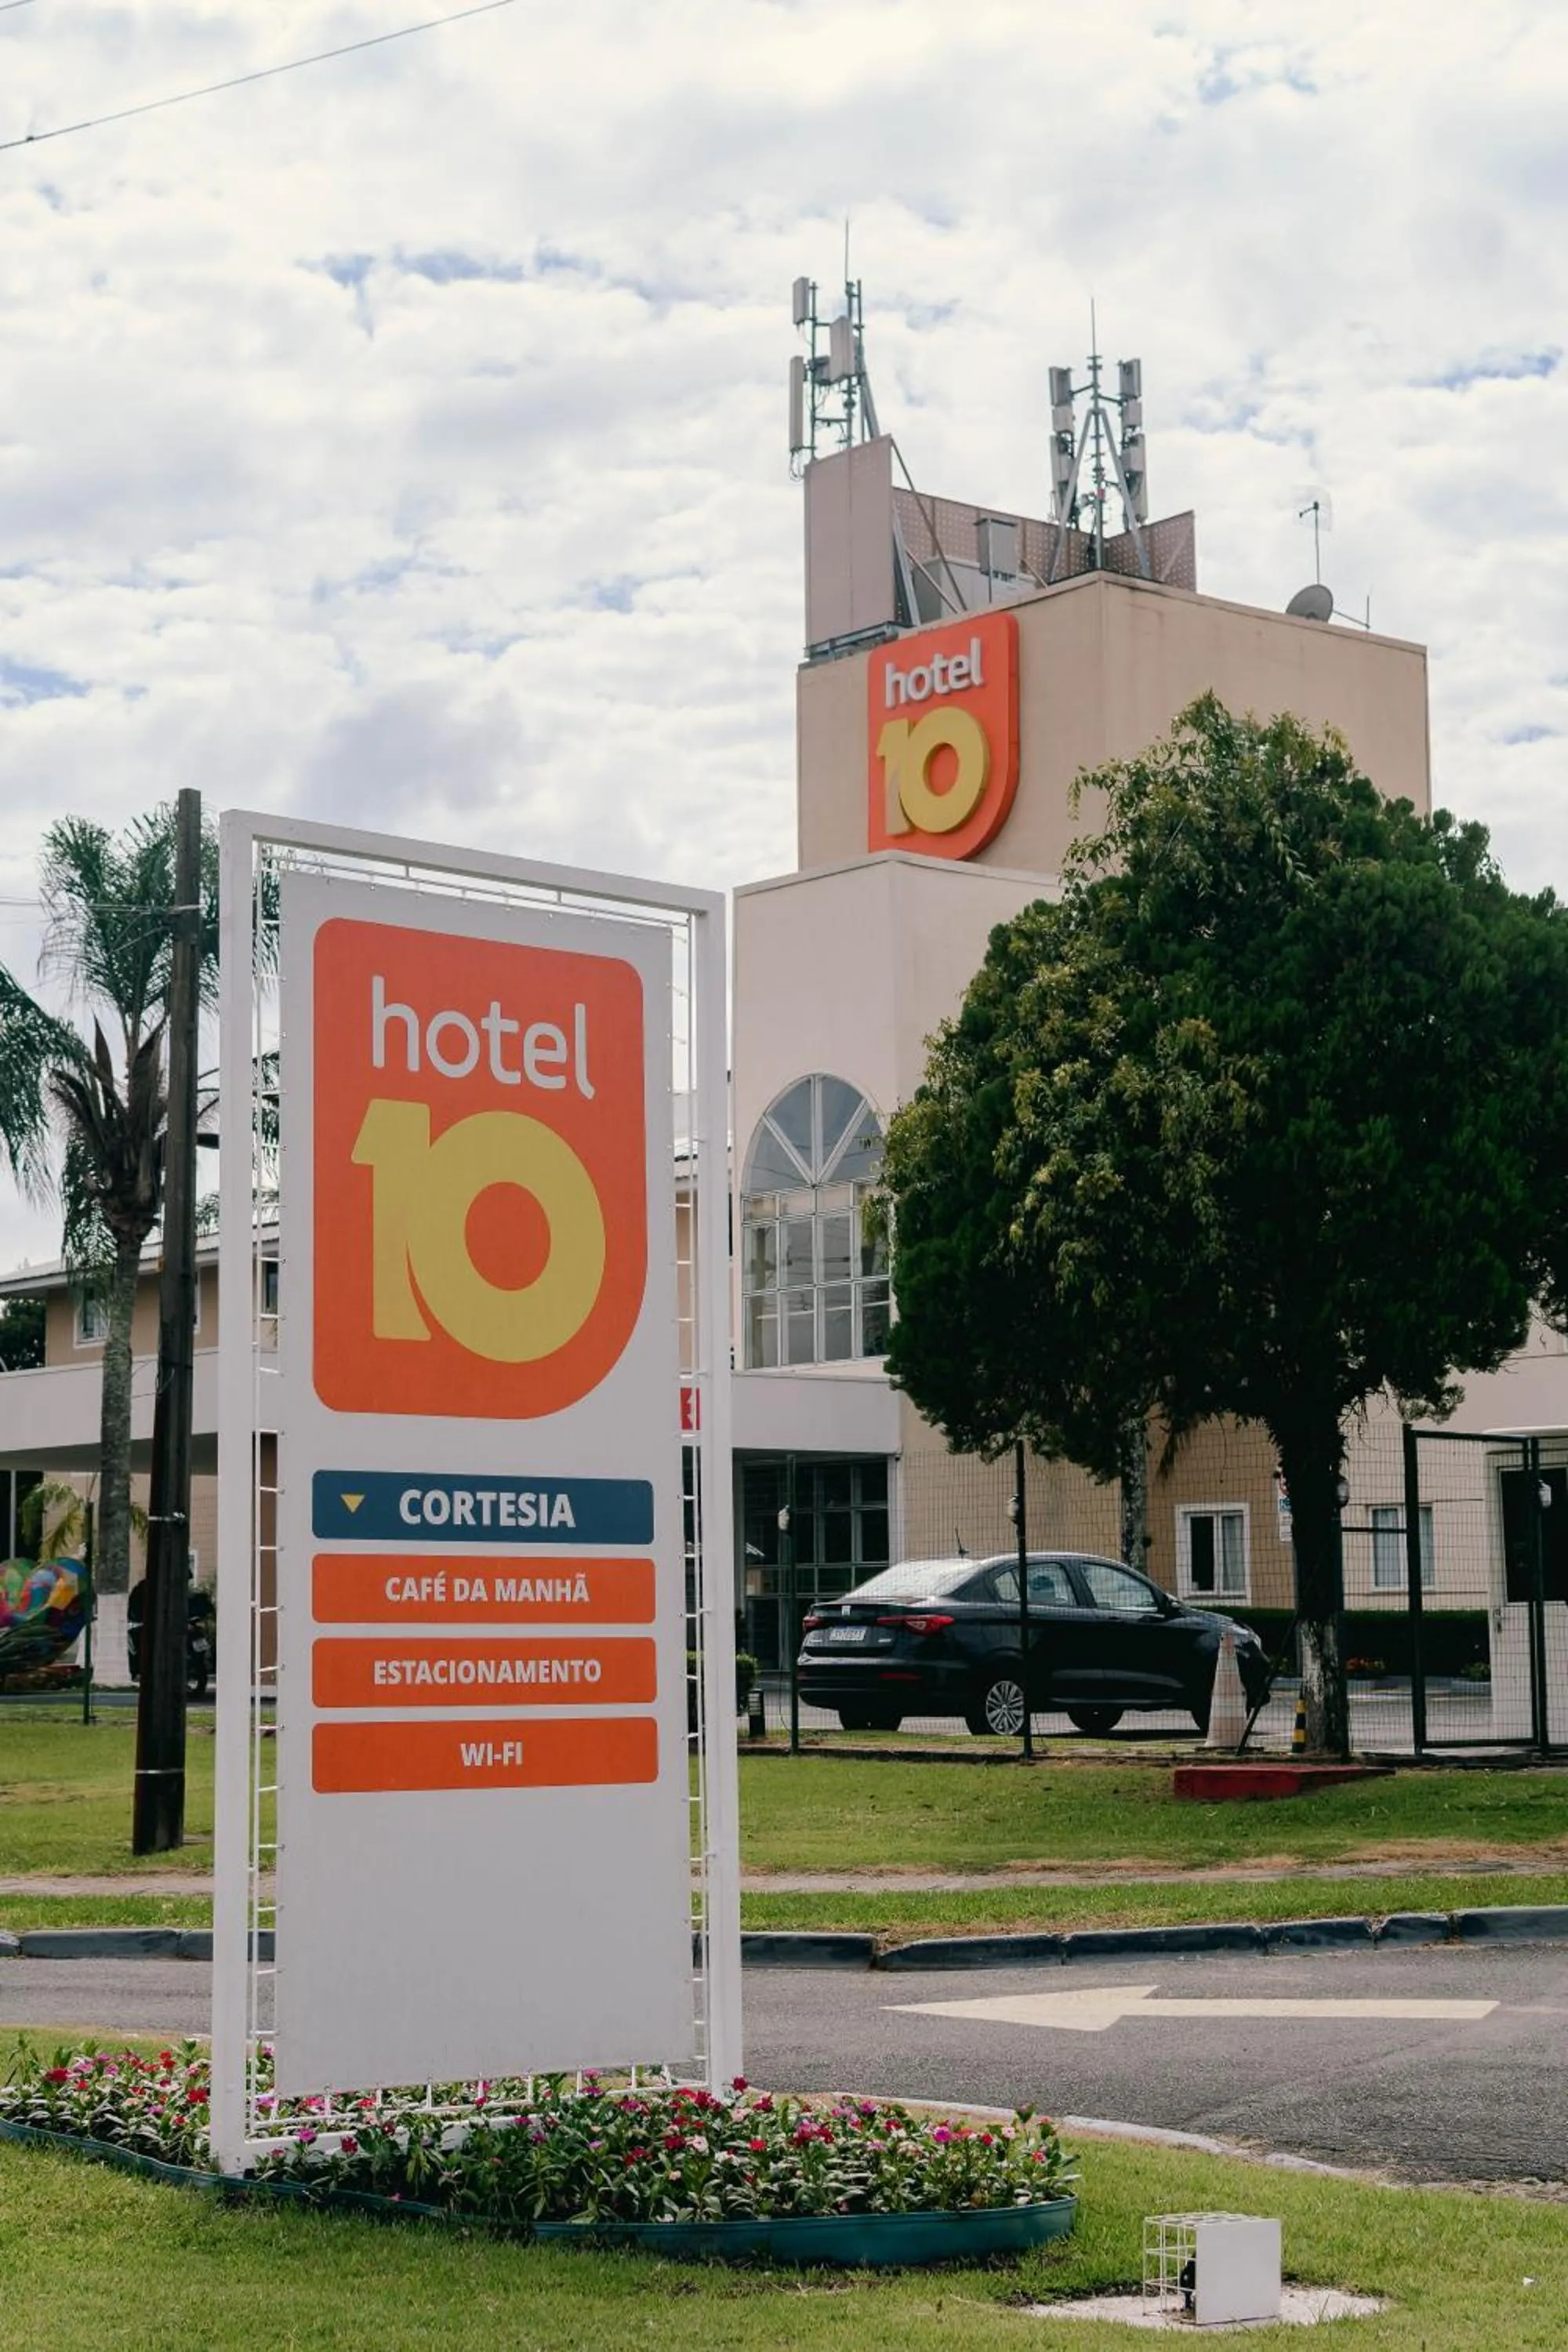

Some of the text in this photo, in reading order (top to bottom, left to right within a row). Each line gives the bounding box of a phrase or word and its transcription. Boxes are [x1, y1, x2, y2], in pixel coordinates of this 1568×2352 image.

[885, 637, 983, 707] hotel
[877, 706, 989, 835] 10
[372, 975, 595, 1099] hotel
[350, 1098, 606, 1363] 10
[399, 1490, 576, 1528] CORTESIA
[385, 1571, 590, 1602] CAFÉ DA MANHÃ
[374, 1659, 601, 1685] ESTACIONAMENTO
[460, 1741, 523, 1766] WI-FI
